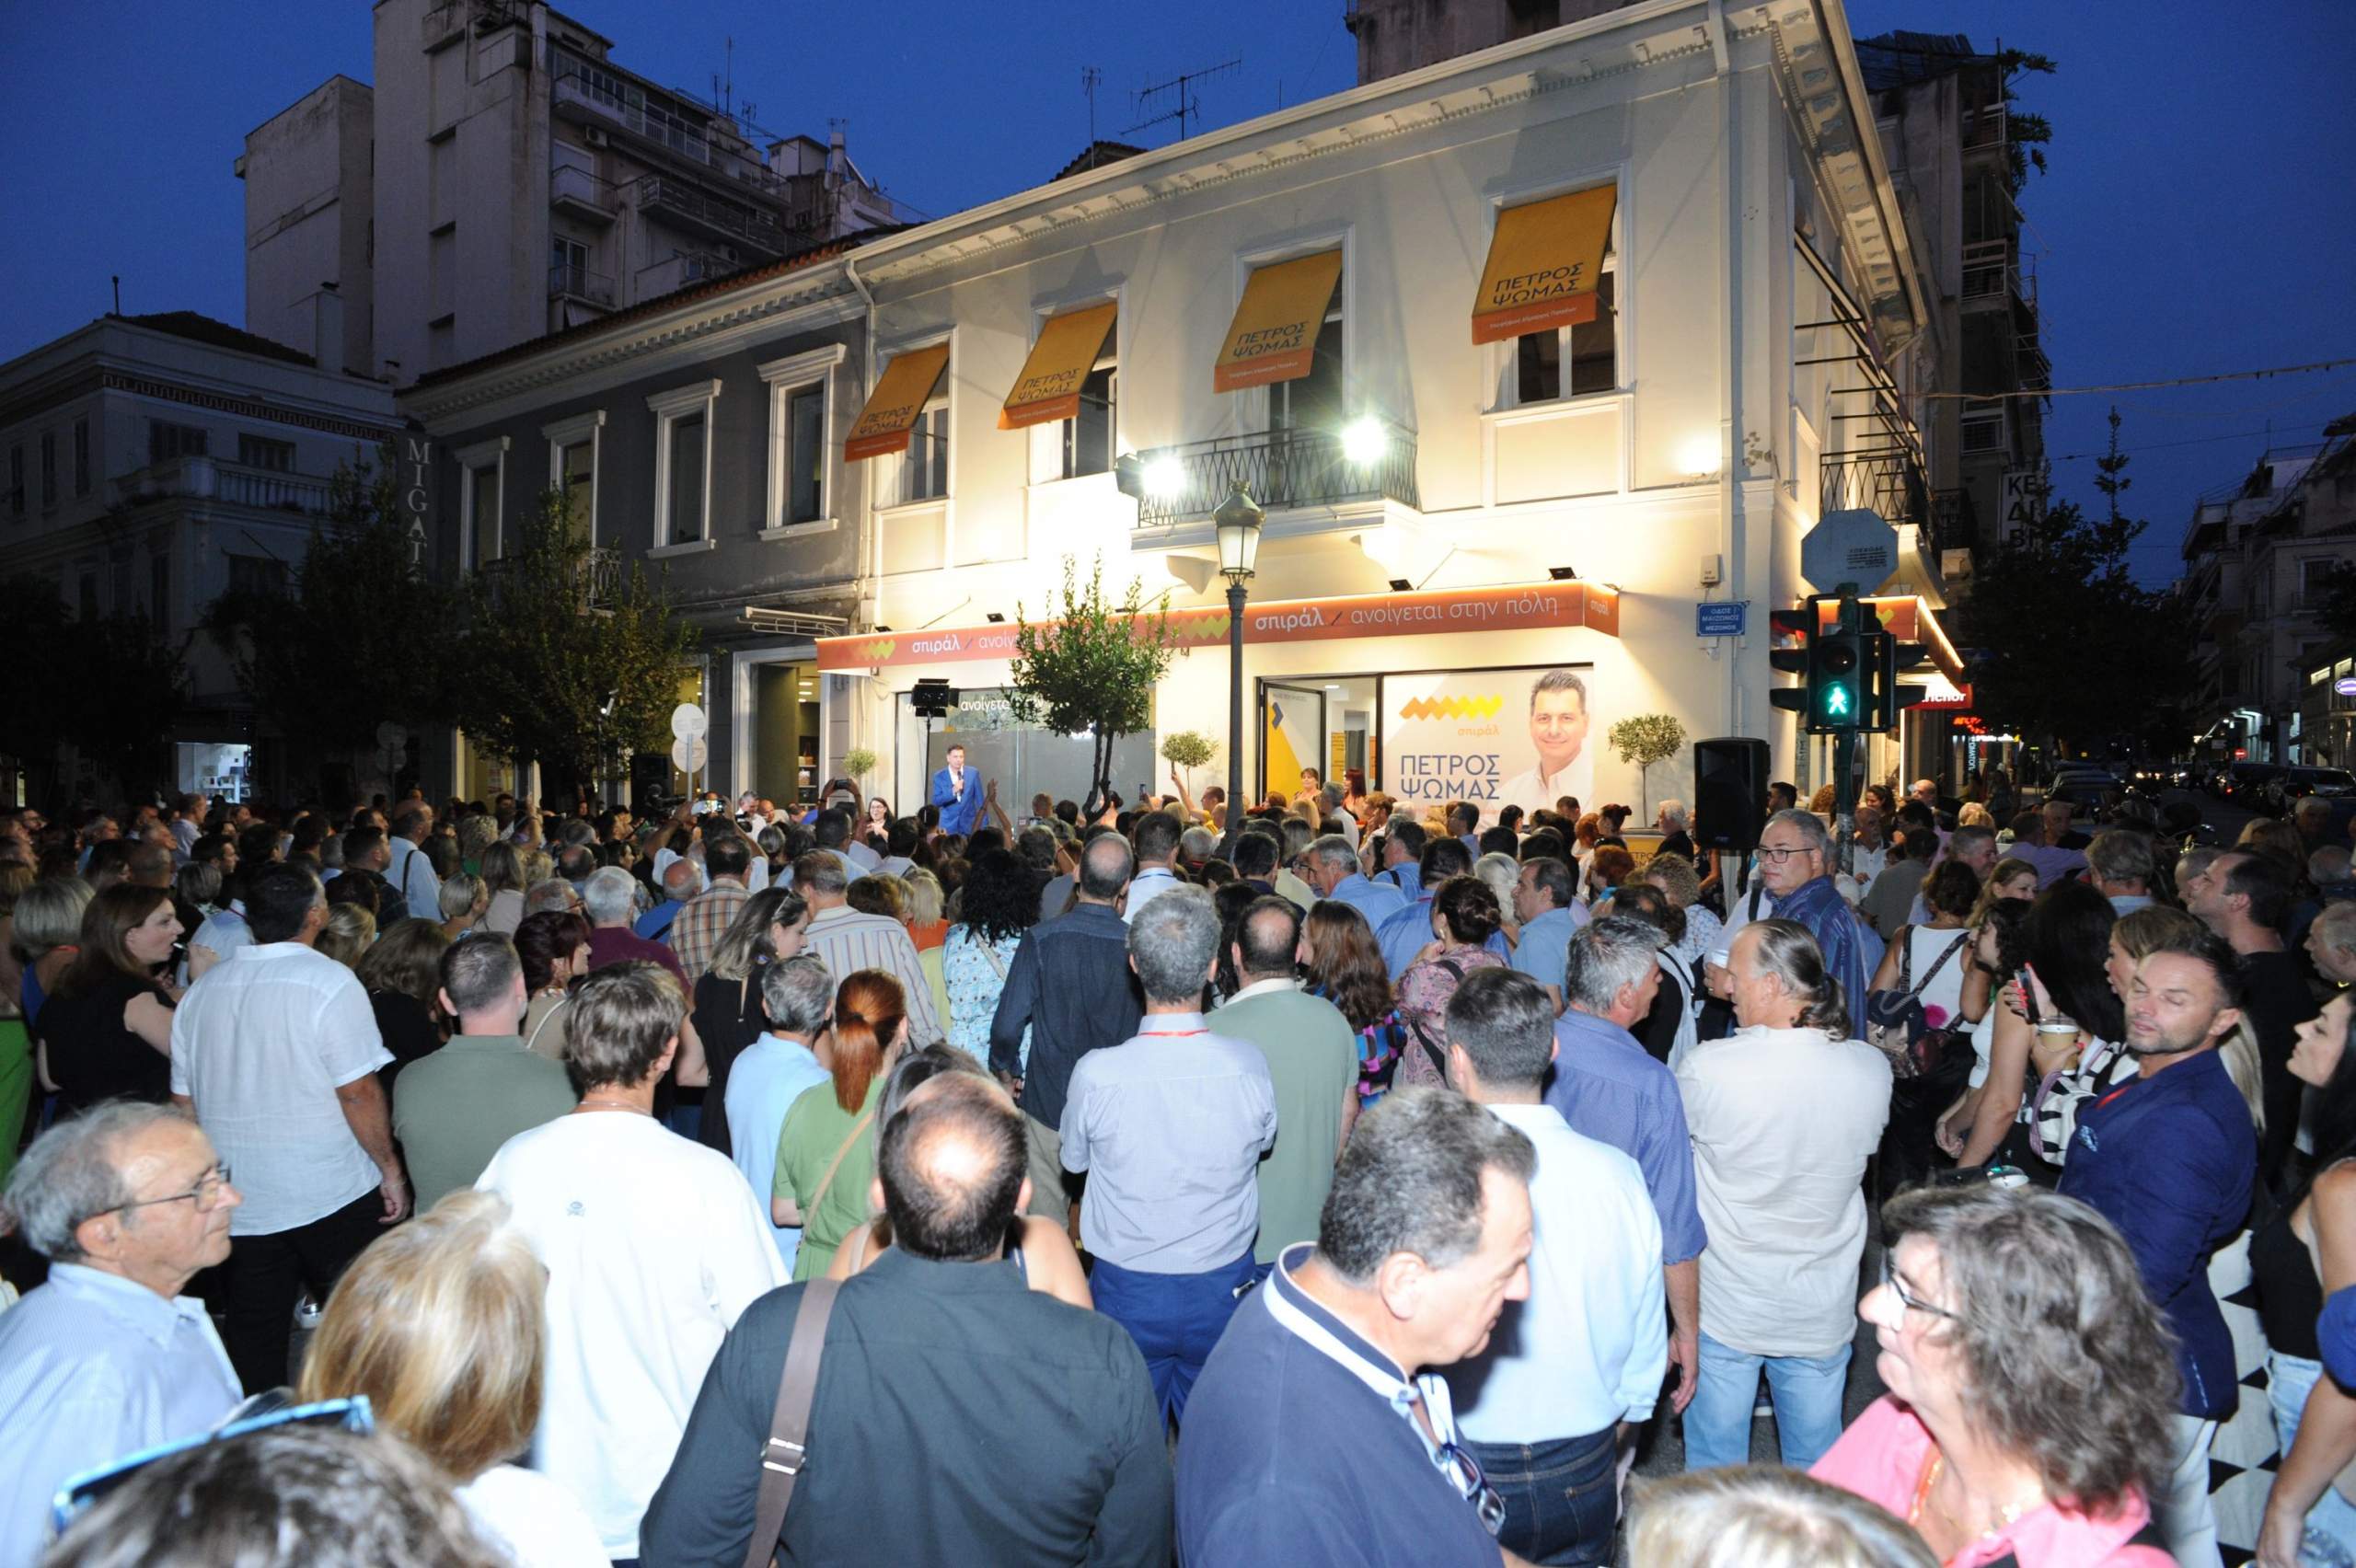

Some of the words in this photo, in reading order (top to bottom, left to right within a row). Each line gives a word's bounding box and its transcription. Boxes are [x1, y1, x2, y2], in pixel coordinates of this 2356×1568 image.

[1496, 262, 1583, 293] ΠΕΤΡΟΣ
[1494, 278, 1579, 306] ΨΩΜΑΣ
[1237, 321, 1309, 345] ΠΕΤΡΟΣ
[1233, 334, 1303, 357] ΨΩΜΑΣ
[1023, 368, 1080, 389] ΠΕΤΡΟΣ
[1019, 381, 1074, 401] ΨΩΜΑΣ
[1255, 606, 1324, 632] σπιράλ
[1351, 601, 1443, 626] ανοίγεται
[1449, 601, 1498, 621] στην
[1507, 592, 1557, 617] πόλη
[912, 634, 960, 654] σπιράλ
[1458, 722, 1500, 738] σπιράλ
[1401, 755, 1500, 776] ΠΕΤΡΟΣ
[1401, 778, 1500, 800] ΨΩΜΑΣ
